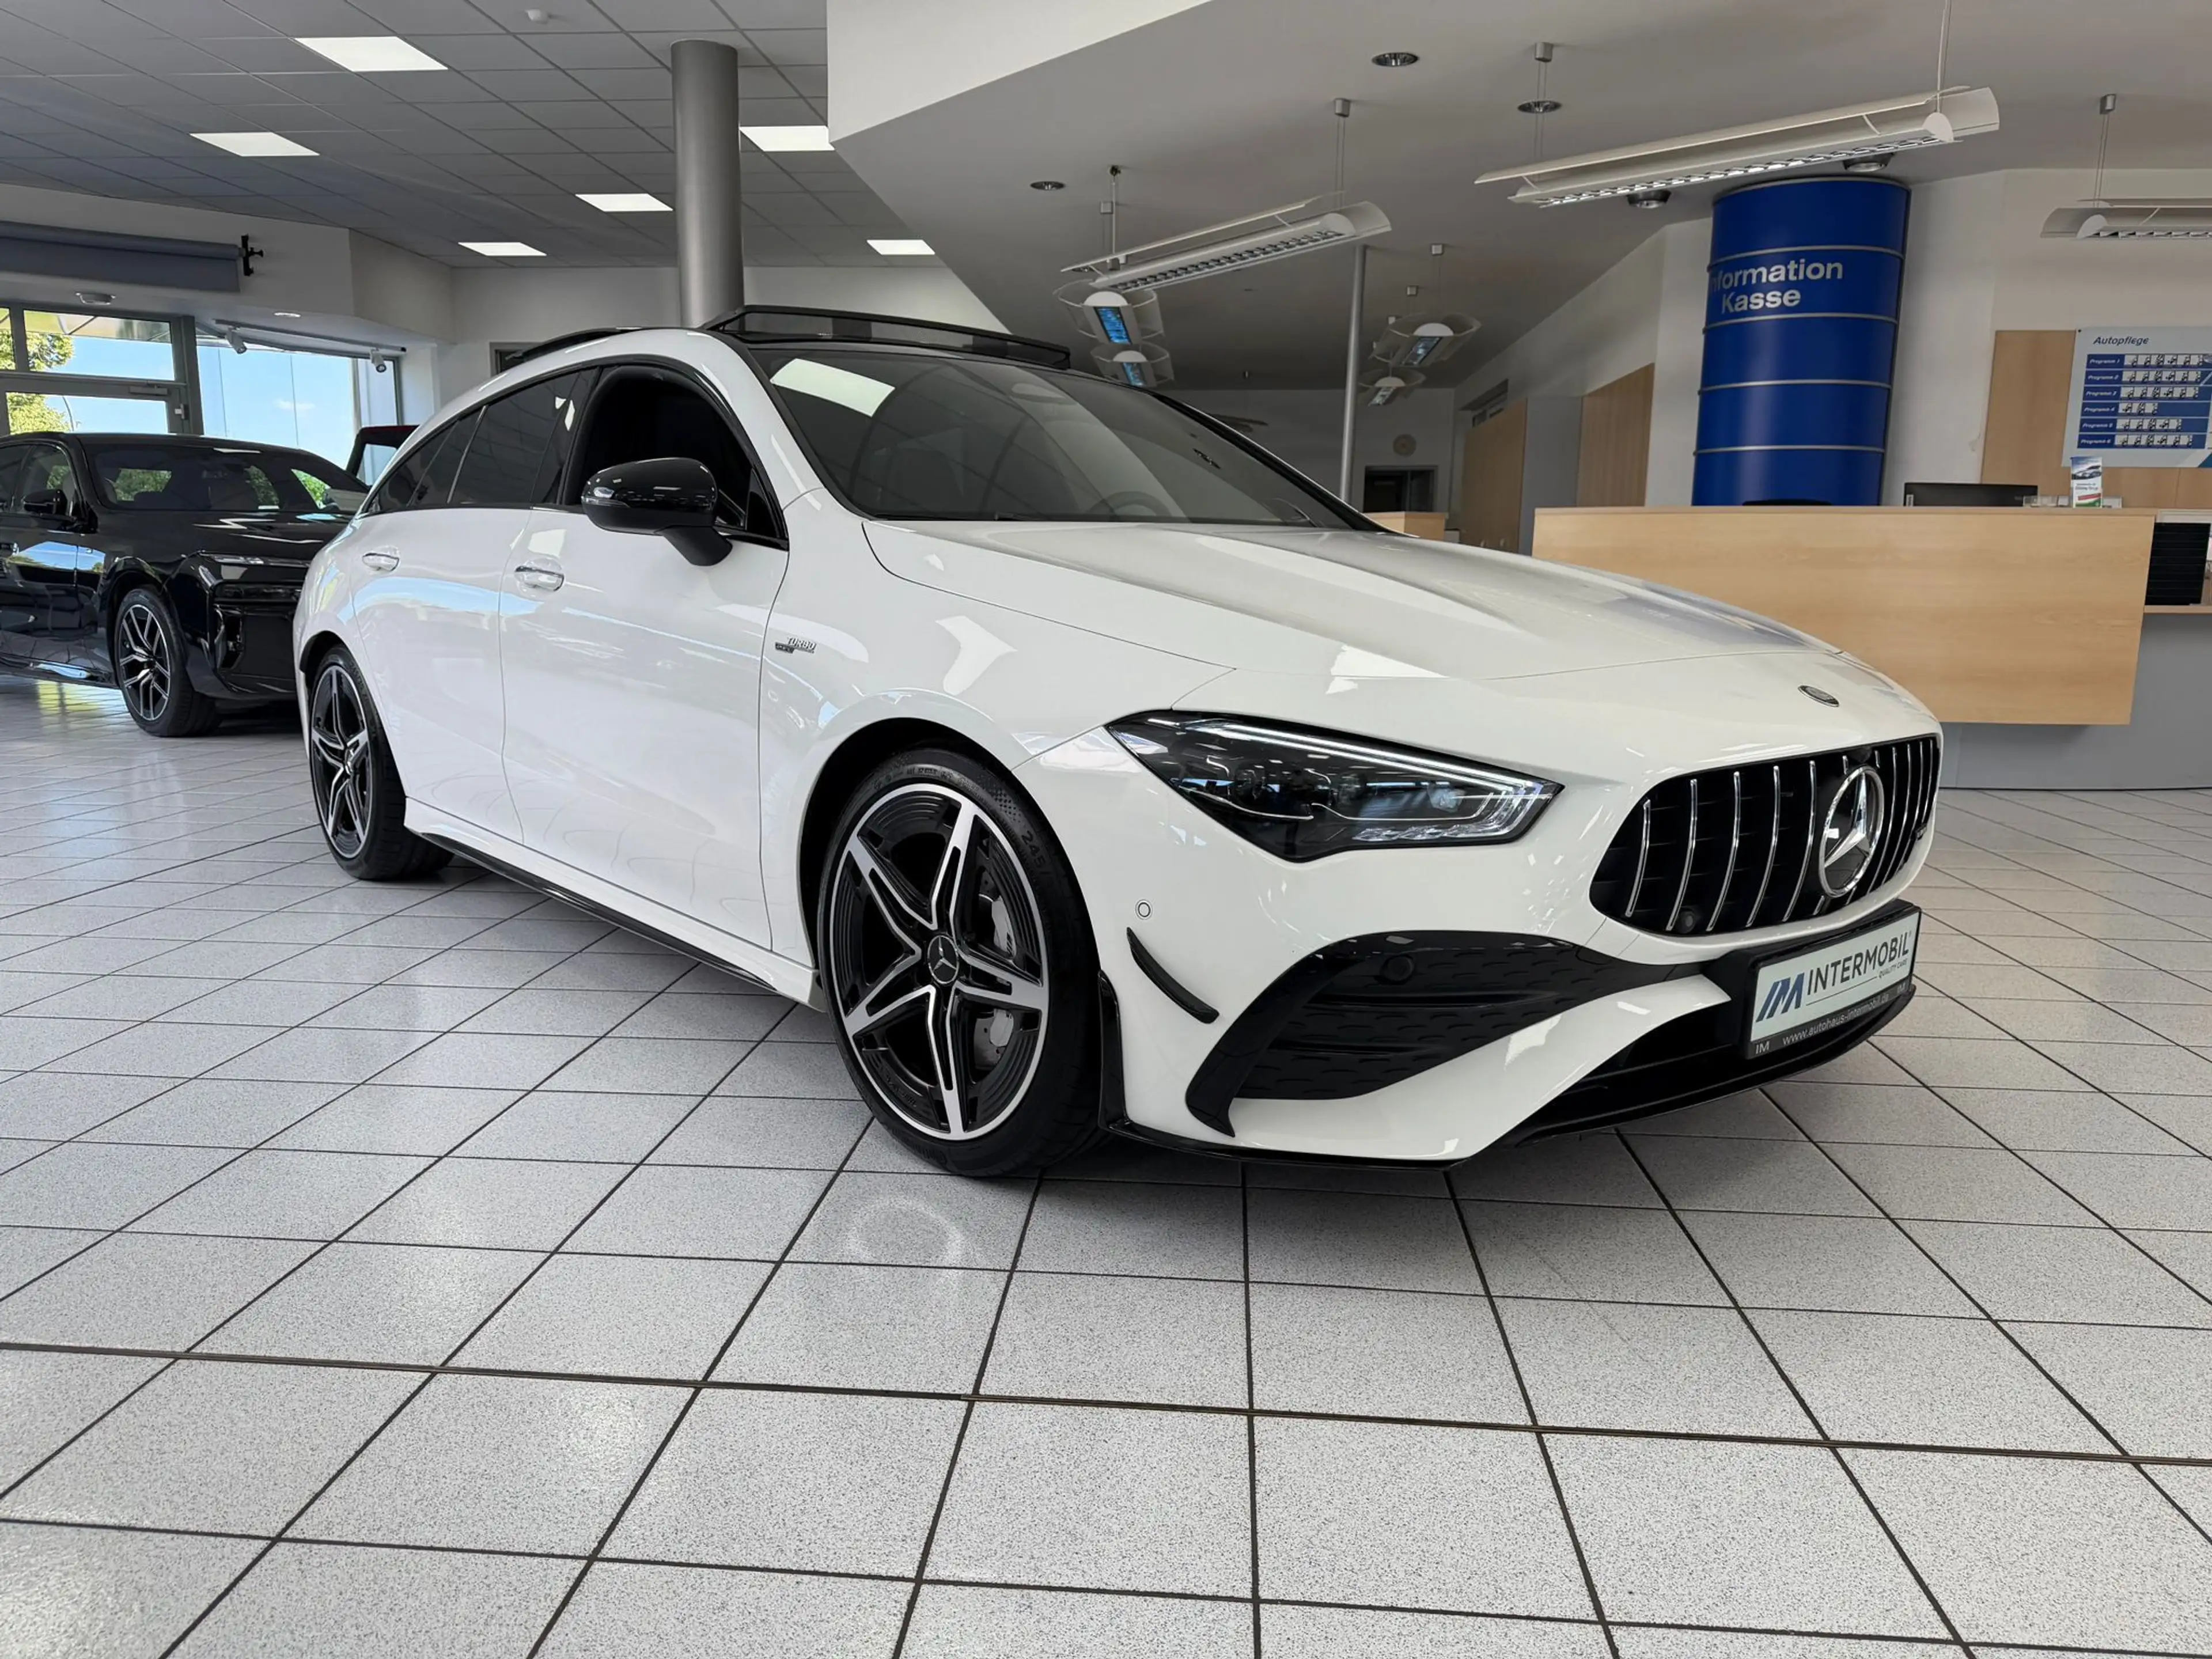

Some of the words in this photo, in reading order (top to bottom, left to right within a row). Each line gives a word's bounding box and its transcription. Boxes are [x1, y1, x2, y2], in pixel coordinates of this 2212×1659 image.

[1711, 259, 1843, 293] nformation
[1721, 289, 1801, 315] Kasse
[2093, 336, 2149, 346] Autopflege
[1807, 932, 1909, 995] INTERMOBIL
[1755, 1041, 1770, 1054] IM
